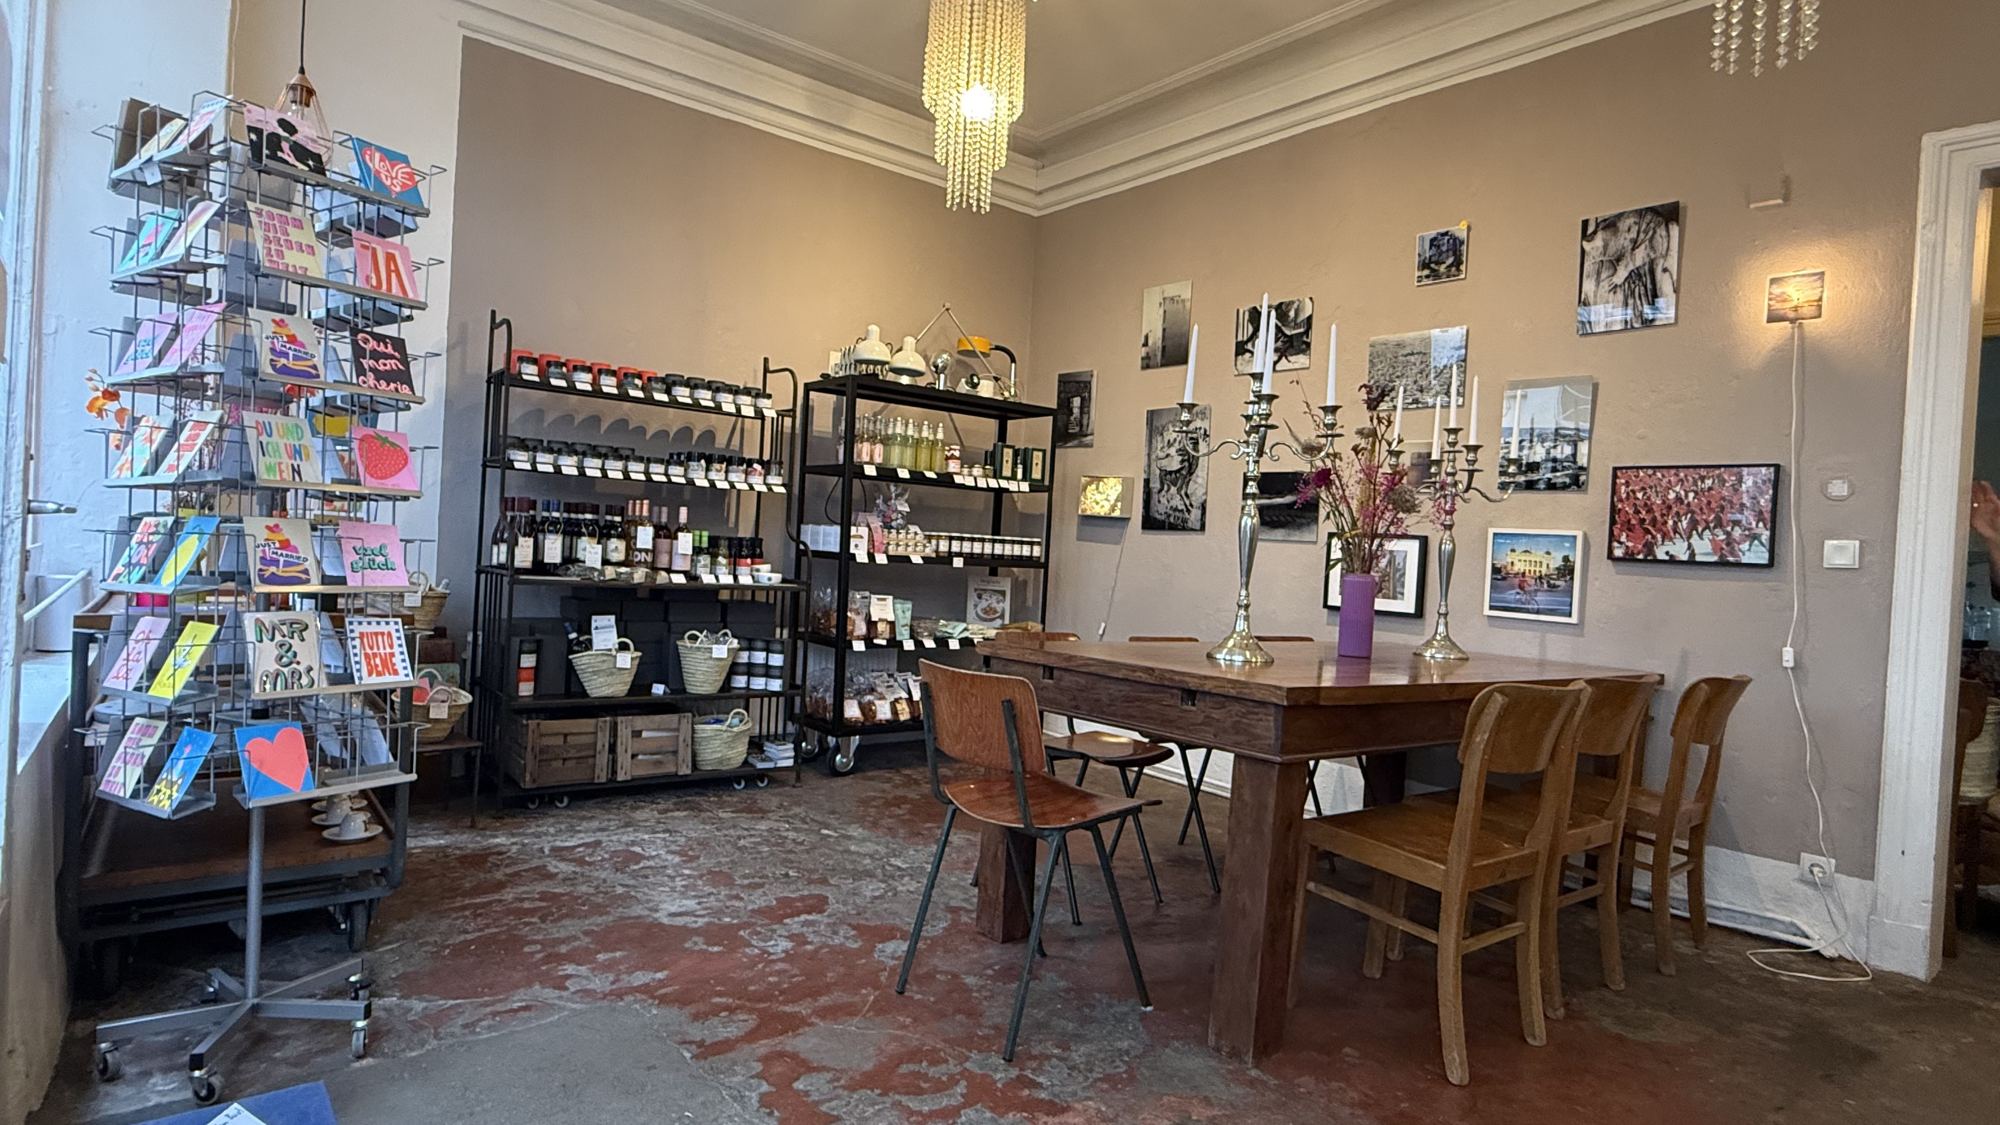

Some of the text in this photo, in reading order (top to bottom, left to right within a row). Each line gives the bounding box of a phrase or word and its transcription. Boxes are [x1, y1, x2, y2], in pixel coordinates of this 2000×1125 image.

[360, 243, 409, 298] JA
[280, 342, 317, 360] MARRIED
[357, 333, 400, 359] Oui
[255, 420, 304, 441] DU UND
[259, 440, 310, 463] ICH UND
[263, 461, 304, 482] WEIN
[271, 550, 309, 563] MARRIED
[255, 617, 309, 643] MR
[359, 630, 395, 652] TUTTO
[274, 639, 301, 668] &
[363, 651, 400, 678] BENE
[260, 664, 316, 693] MRS
